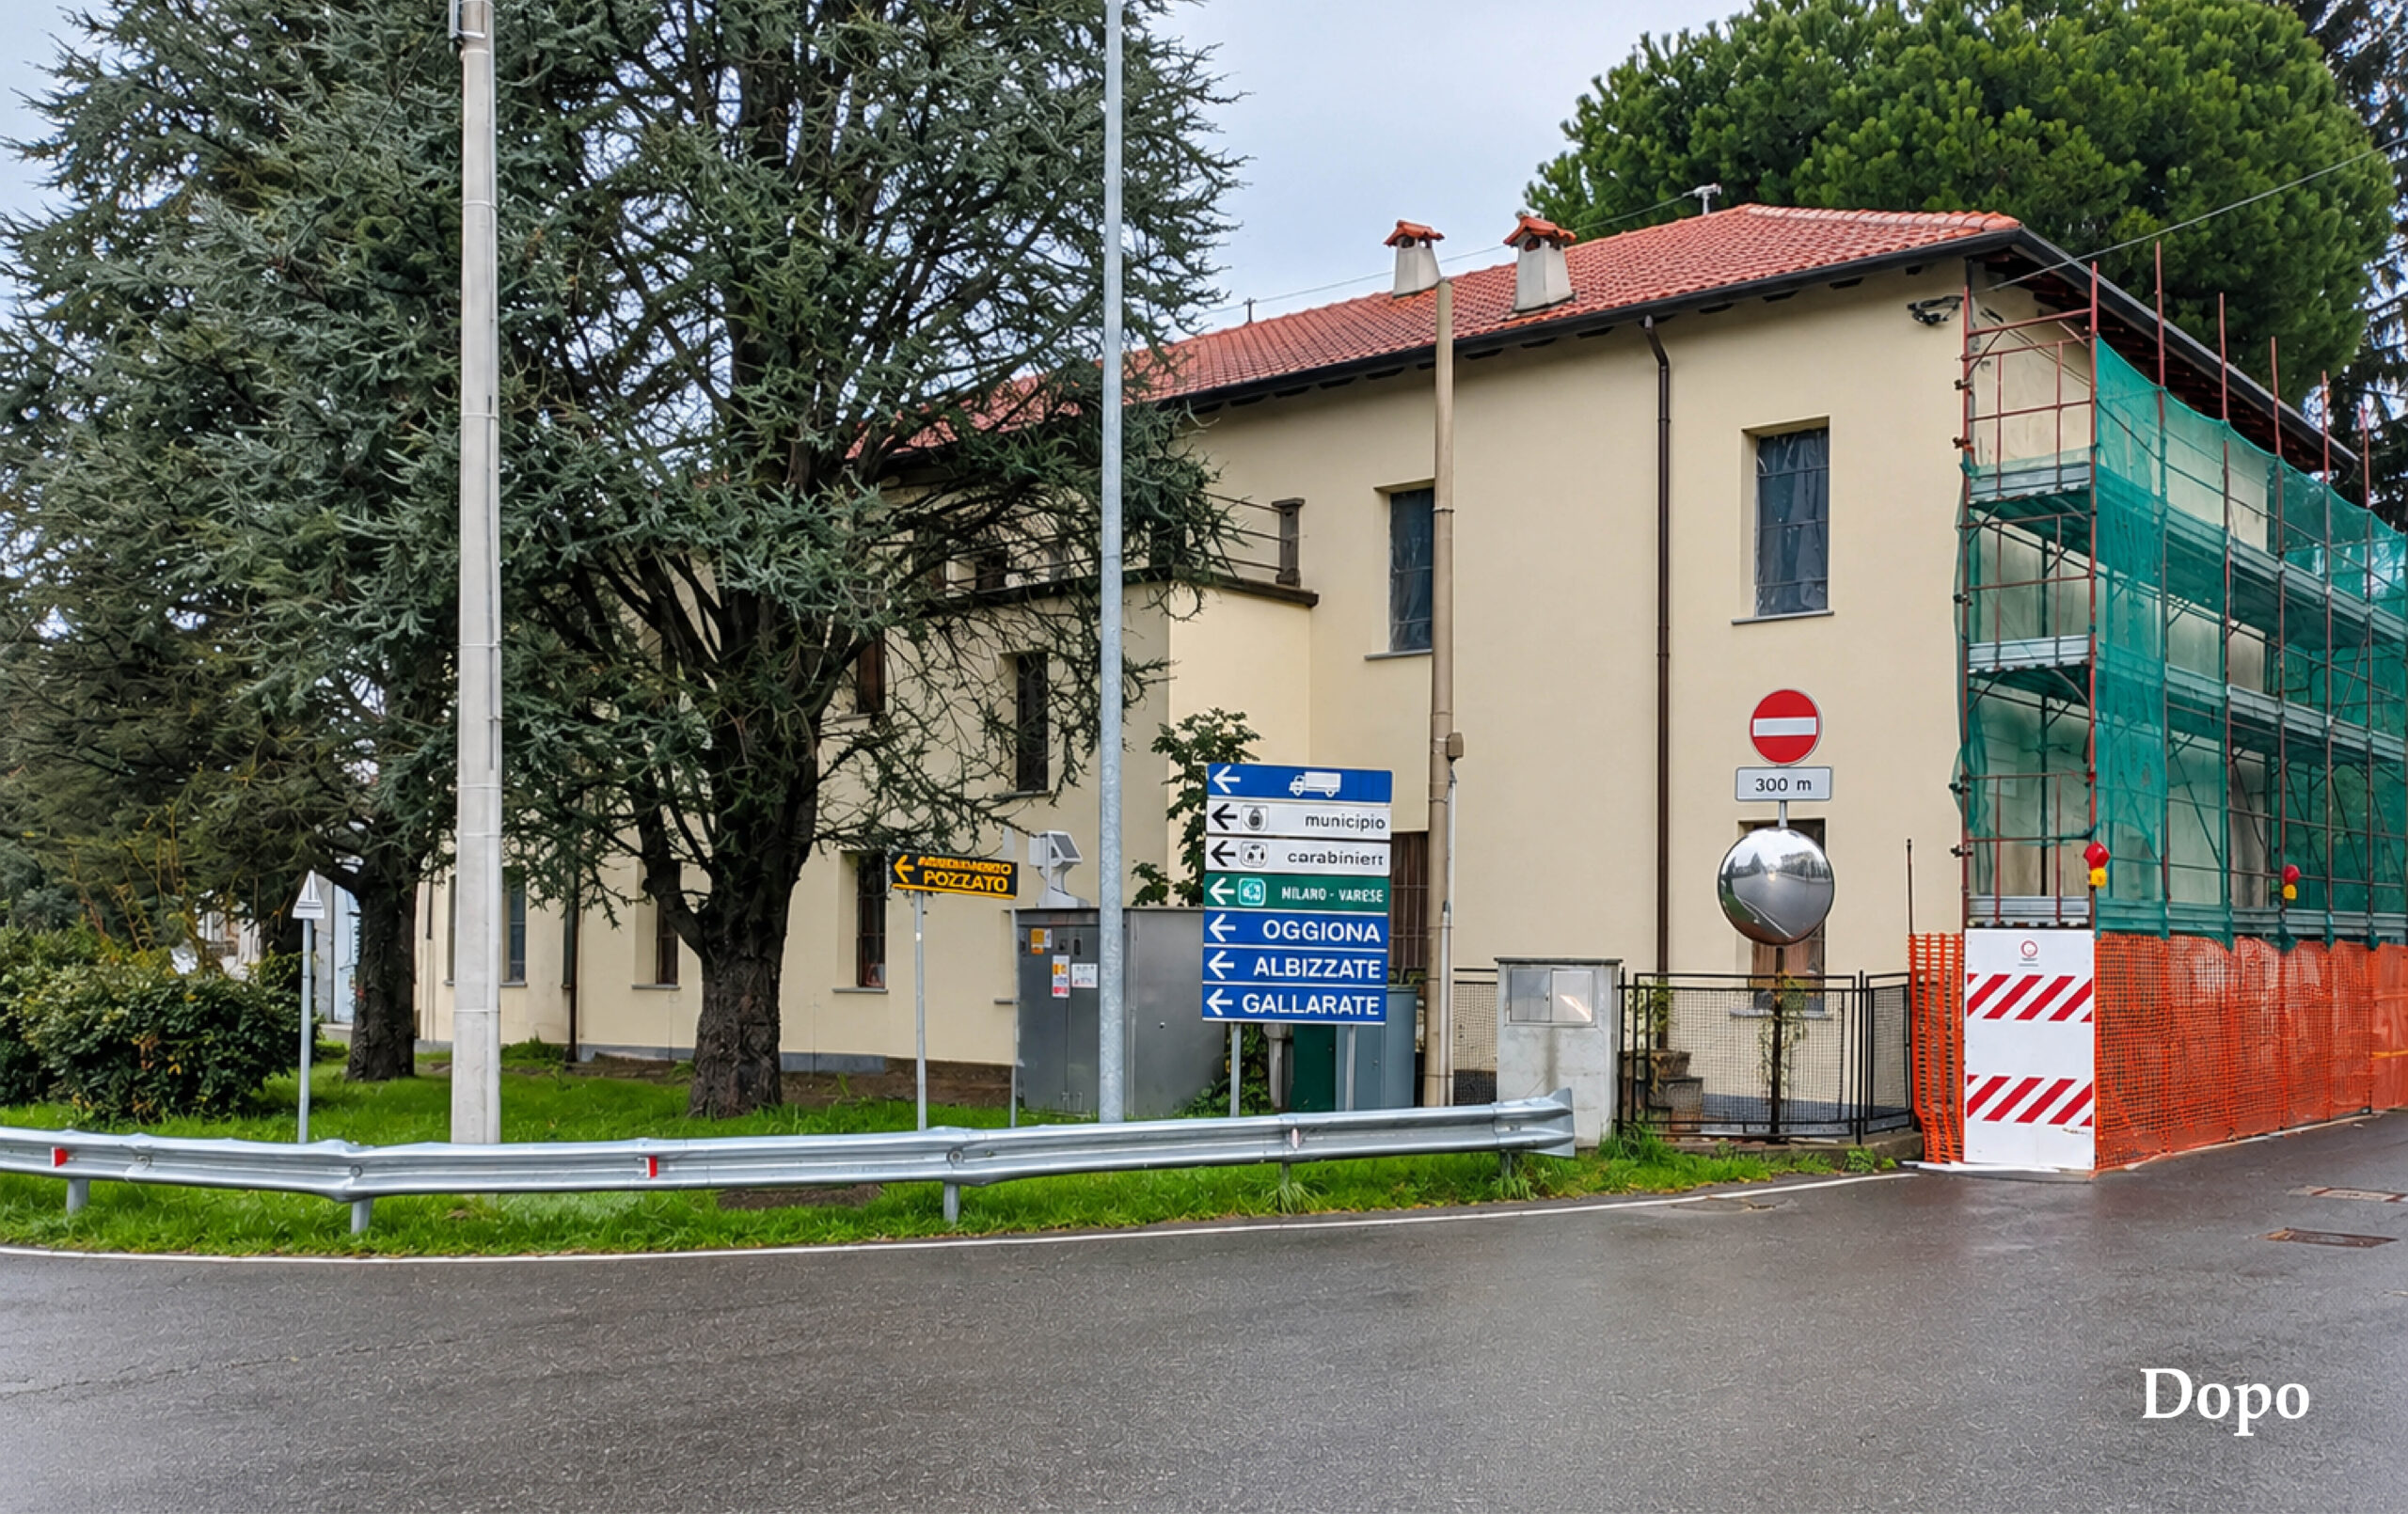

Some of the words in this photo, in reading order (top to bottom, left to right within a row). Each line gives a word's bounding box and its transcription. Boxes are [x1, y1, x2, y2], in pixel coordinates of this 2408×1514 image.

[1754, 777, 1788, 792] 300
[1797, 779, 1813, 791] m
[1305, 812, 1386, 832] municipio
[923, 869, 1008, 892] POZZATO
[1338, 888, 1384, 903] VARESE
[1262, 919, 1381, 942] OGGIONA
[1253, 955, 1381, 979] ALBIZZATE
[1242, 992, 1380, 1017] GALLARATE
